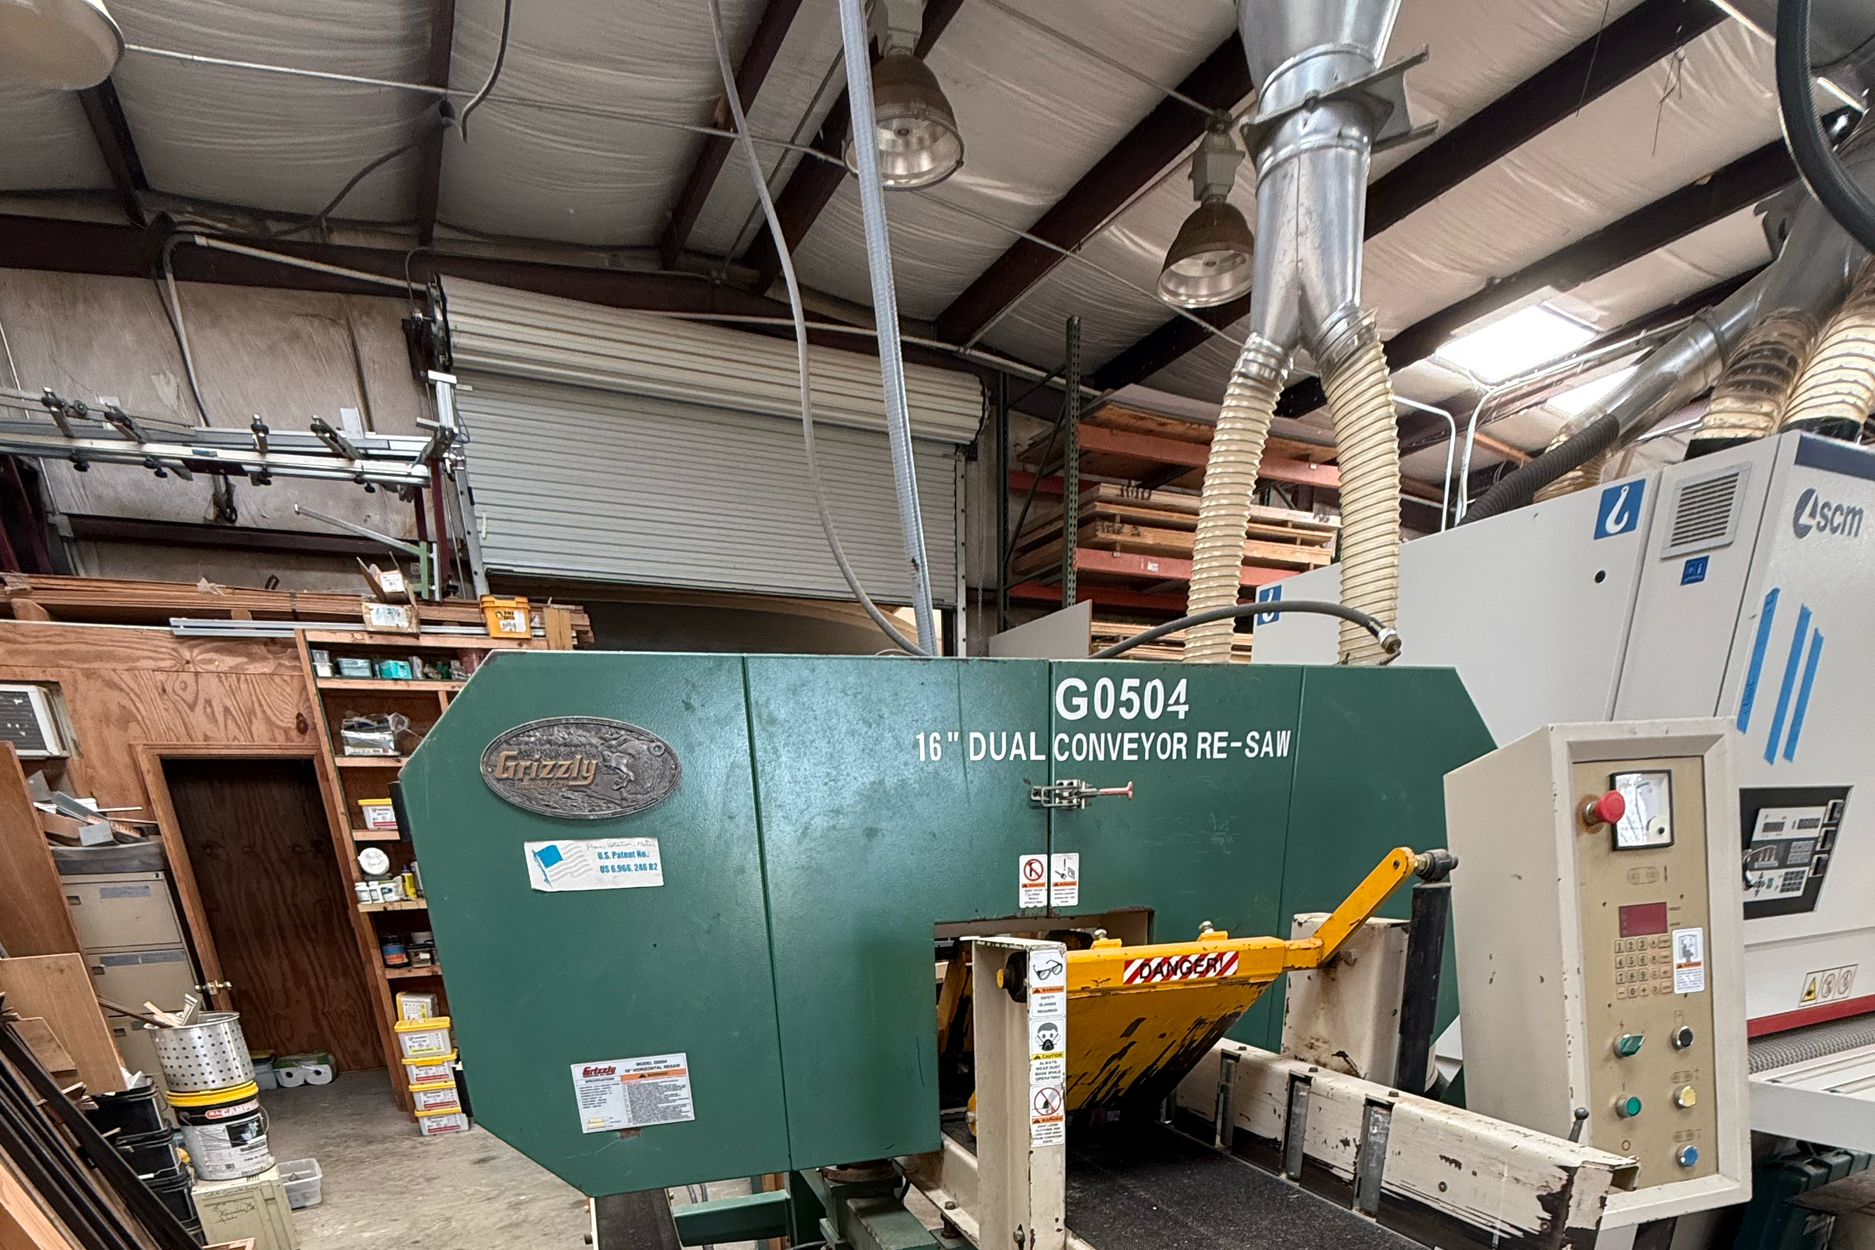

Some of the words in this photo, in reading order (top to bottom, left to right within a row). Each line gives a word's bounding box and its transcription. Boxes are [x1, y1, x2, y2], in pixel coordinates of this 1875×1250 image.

[1816, 500, 1864, 538] scm
[1055, 677, 1190, 721] G0504
[915, 731, 959, 762] 16"
[969, 731, 1046, 761] DUAL
[1053, 731, 1189, 762] CONVEYOR
[1195, 729, 1292, 760] RE-SAW
[495, 750, 599, 787] Grizzly
[597, 851, 611, 860] U.S.
[611, 850, 636, 859] Patent
[600, 865, 610, 873] US
[1139, 956, 1224, 979] DANGER!
[582, 1065, 617, 1077] Grizzly
